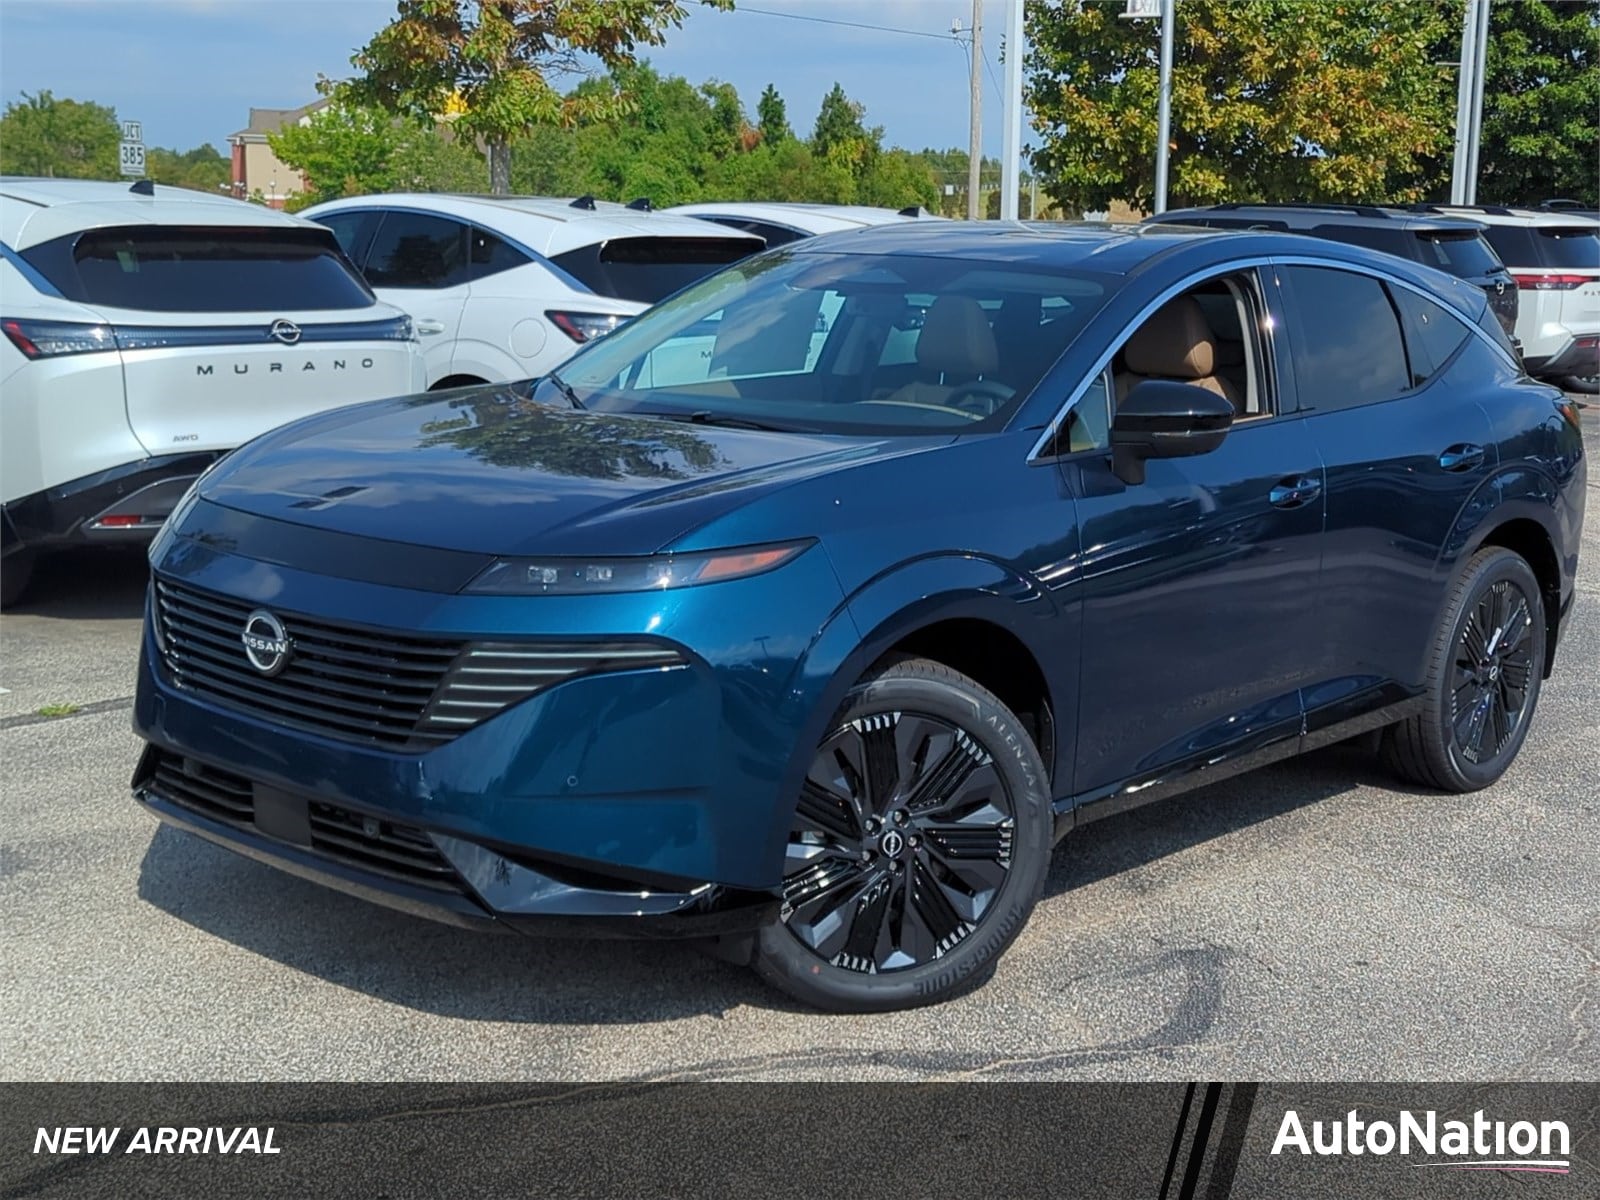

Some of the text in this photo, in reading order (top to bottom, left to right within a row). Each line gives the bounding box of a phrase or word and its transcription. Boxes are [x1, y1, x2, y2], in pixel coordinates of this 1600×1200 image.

[123, 124, 140, 139] JCT
[122, 146, 144, 165] 385
[196, 357, 374, 376] MURANO
[986, 715, 1037, 787] ALENZA
